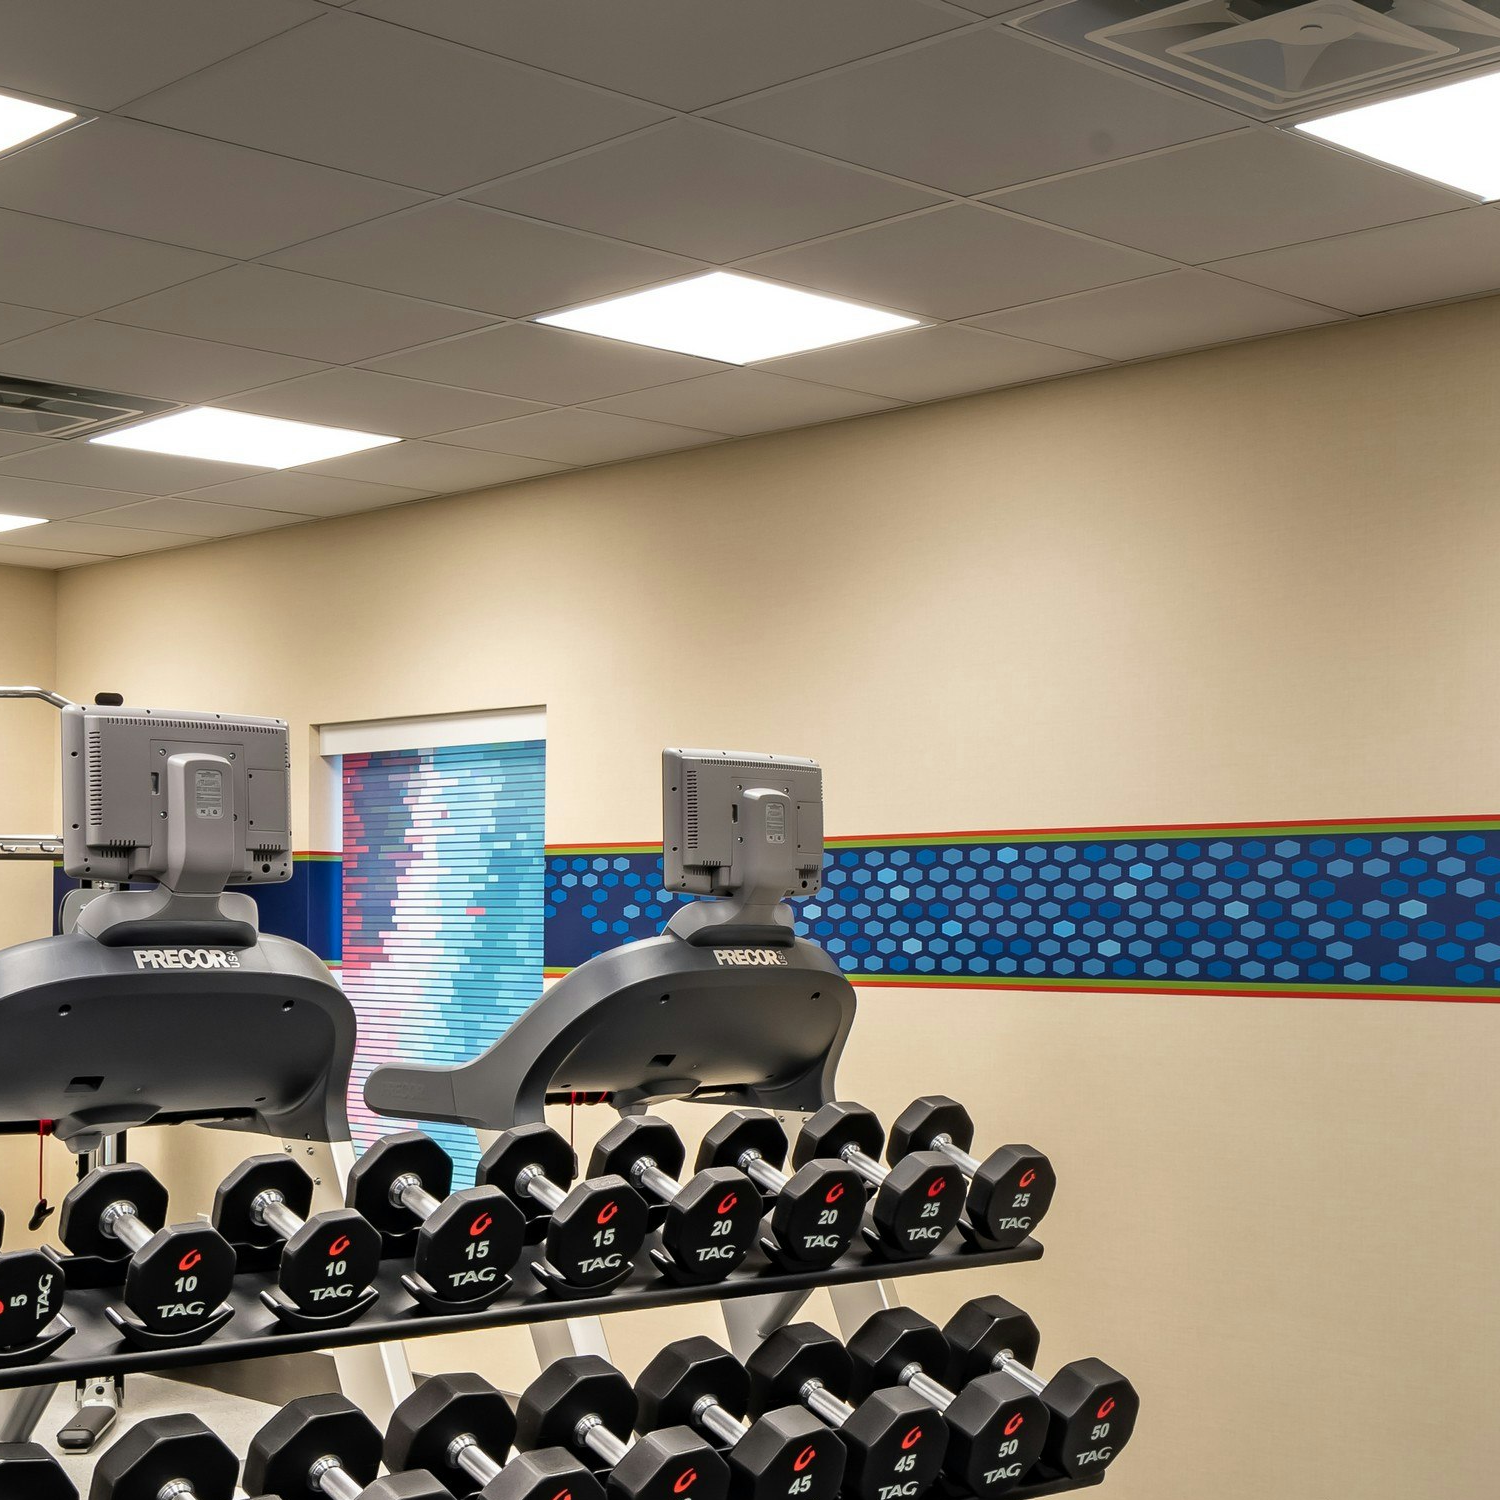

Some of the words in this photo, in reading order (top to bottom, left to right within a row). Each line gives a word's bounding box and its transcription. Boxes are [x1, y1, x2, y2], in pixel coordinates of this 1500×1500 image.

[133, 949, 231, 969] PRECOR
[227, 950, 241, 968] USA
[713, 949, 781, 965] PRECOR
[1012, 1193, 1030, 1207] 25
[818, 1210, 837, 1224] 20
[921, 1202, 940, 1217] 25
[711, 1220, 732, 1236] 20
[999, 1217, 1031, 1229] TAG
[593, 1229, 615, 1247] 15
[907, 1226, 942, 1240] TAG
[804, 1235, 839, 1248] TAG
[466, 1241, 489, 1259] 15
[696, 1245, 735, 1261] TAG
[326, 1261, 346, 1276] 10
[578, 1254, 622, 1273] TAG
[175, 1276, 197, 1292] 10
[449, 1267, 499, 1288] TAG
[36, 1274, 53, 1319] TAG
[310, 1284, 353, 1300] TAG
[11, 1295, 27, 1306] 5
[157, 1302, 205, 1317] TAG
[1091, 1423, 1109, 1440] 50
[999, 1439, 1018, 1457] 50
[894, 1454, 916, 1472] 45
[1077, 1447, 1114, 1467] TAG
[984, 1463, 1022, 1483] TAG
[789, 1475, 811, 1494] 45
[879, 1481, 918, 1500] TAG
